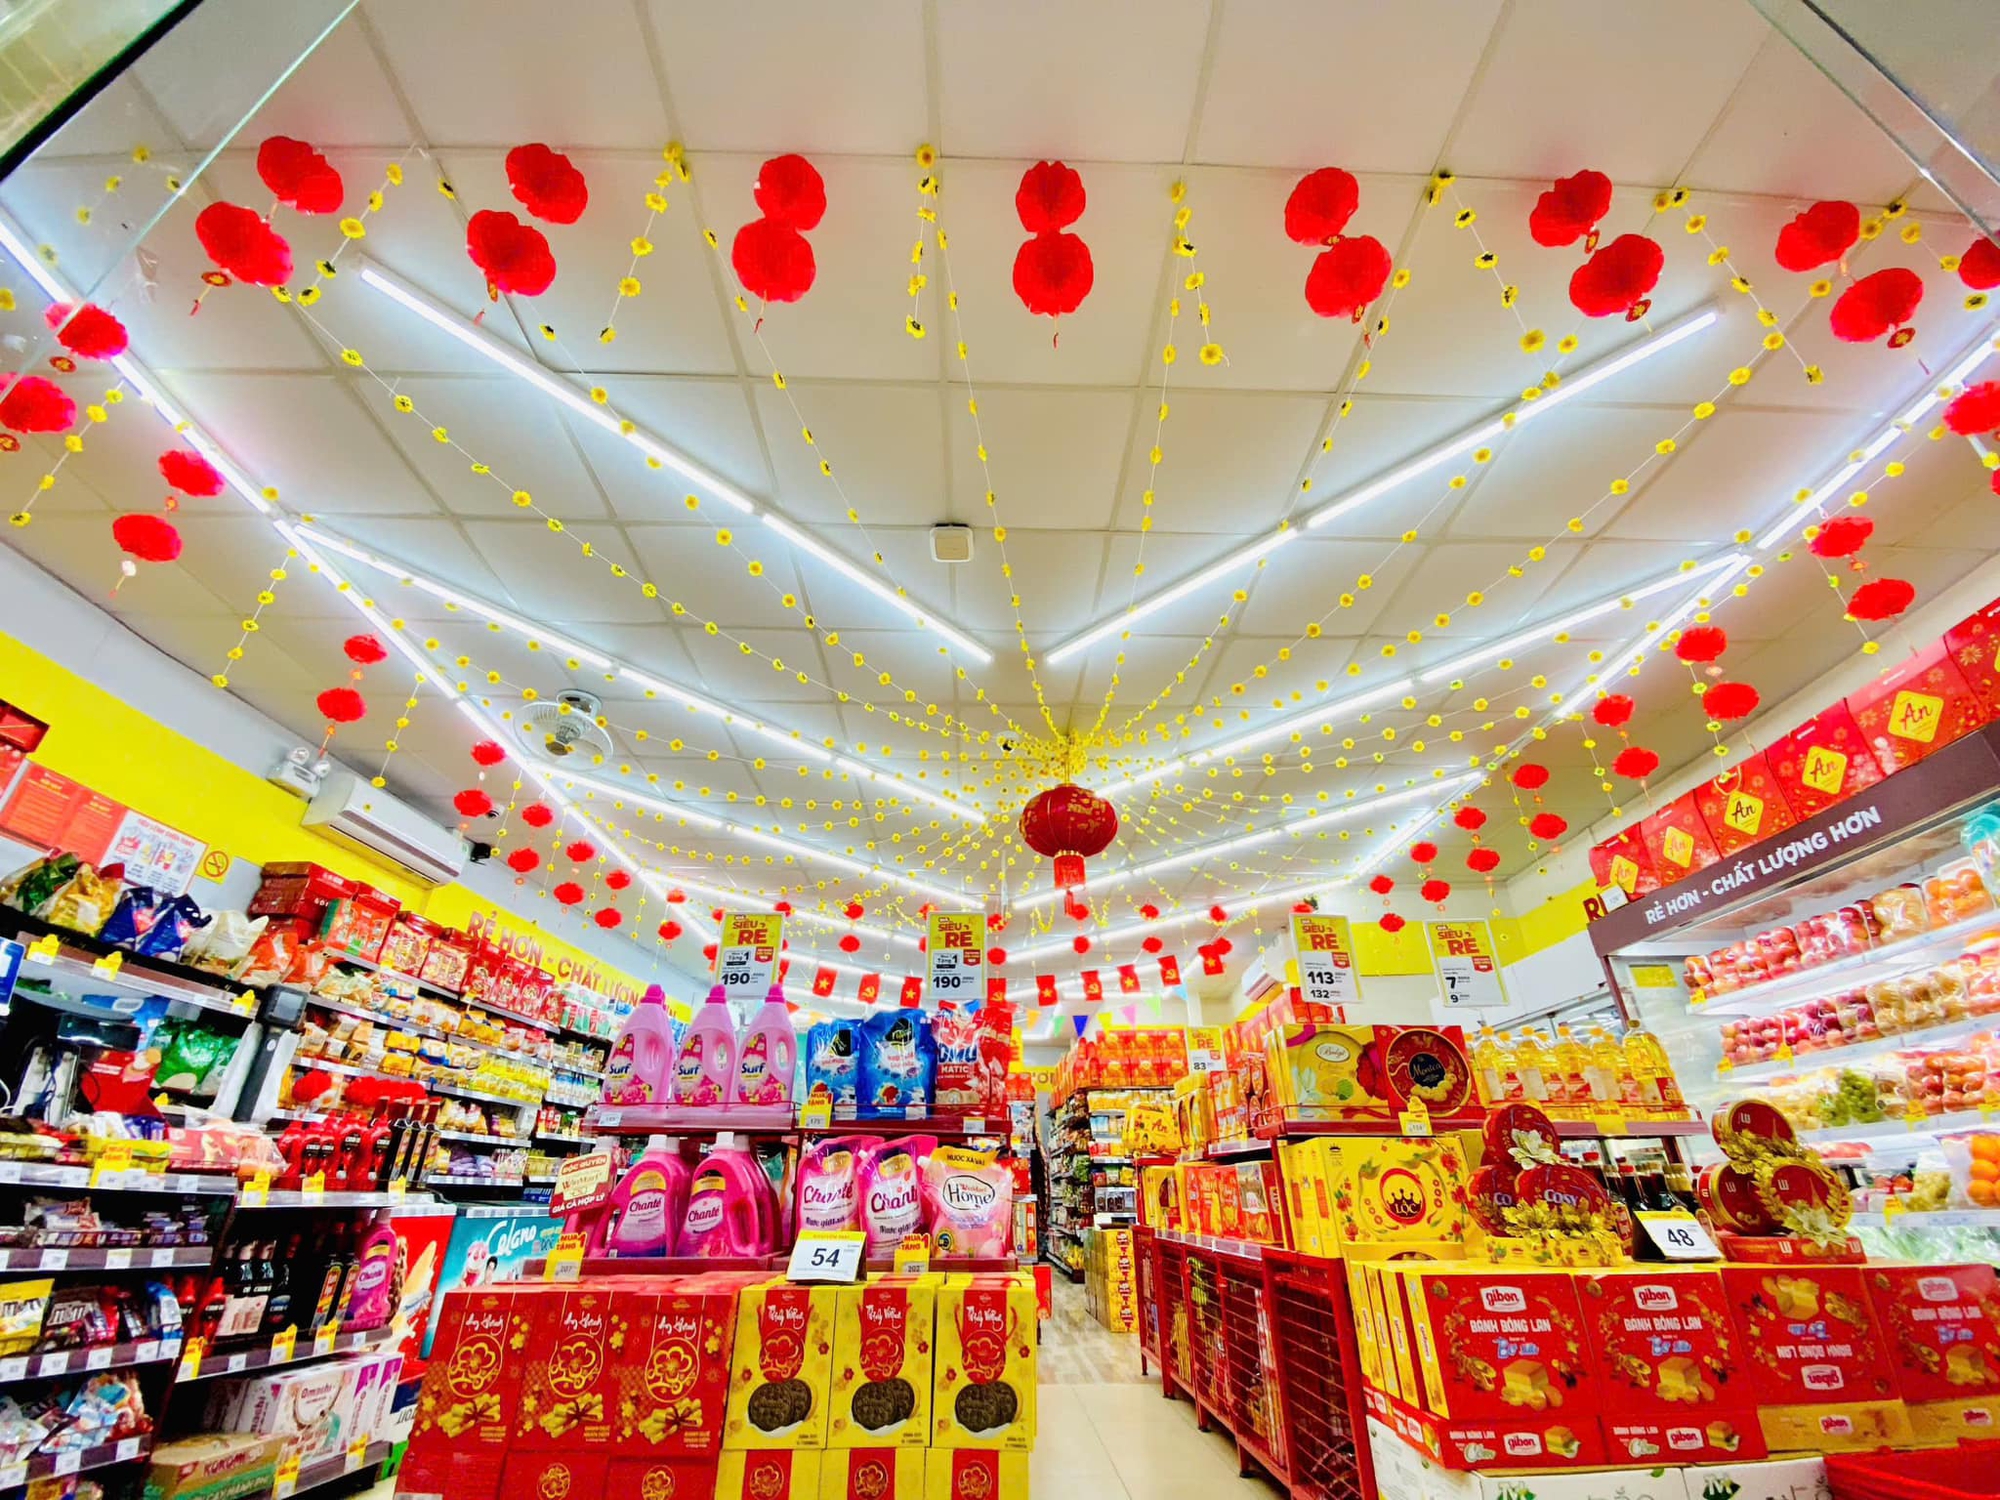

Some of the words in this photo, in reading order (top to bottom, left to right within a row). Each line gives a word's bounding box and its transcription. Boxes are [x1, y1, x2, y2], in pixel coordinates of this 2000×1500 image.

[1899, 702, 1933, 731] An
[1810, 757, 1837, 782] An
[1731, 800, 1756, 823] An
[1645, 901, 1666, 924] RẺ
[1666, 889, 1700, 916] HƠN
[1711, 861, 1756, 895] CHẤT
[1758, 831, 1829, 876] LƯỢNG
[1829, 806, 1882, 842] HƠN
[467, 910, 498, 941] RẺ
[500, 927, 544, 967] HƠN
[557, 956, 601, 991] CHẤT
[722, 973, 750, 985] 190
[933, 976, 961, 988] 190
[1308, 971, 1335, 984] 113
[1445, 976, 1456, 989] 7
[1310, 989, 1330, 998] 132
[1450, 994, 1459, 1003] 9
[609, 1063, 632, 1074] Surf
[678, 1064, 702, 1075] Surf
[741, 1062, 766, 1074] Surf
[1193, 1062, 1207, 1070] 83
[948, 1183, 992, 1205] Home
[1543, 1188, 1580, 1207] COSY
[552, 1205, 566, 1213] GIÁ
[578, 1195, 595, 1206] HỢP
[596, 1193, 605, 1202] LÝ
[630, 1197, 662, 1212] Chanté
[1395, 1198, 1418, 1216] LỘC
[688, 1206, 720, 1222] Chanté
[487, 1219, 537, 1256] Celano
[1667, 1228, 1695, 1247] 48
[811, 1248, 840, 1267] 54
[1485, 1289, 1519, 1306] gibon
[1638, 1288, 1671, 1305] gibon
[1469, 1317, 1499, 1333] BÁNH
[1500, 1316, 1528, 1333] BÔNG
[1530, 1318, 1552, 1332] LAN
[1624, 1315, 1652, 1332] BÁNH
[1653, 1315, 1680, 1331] BÔNG
[1681, 1316, 1703, 1330] LAN
[1508, 1436, 1535, 1451] gibon
[1670, 1430, 1698, 1445] gibon
